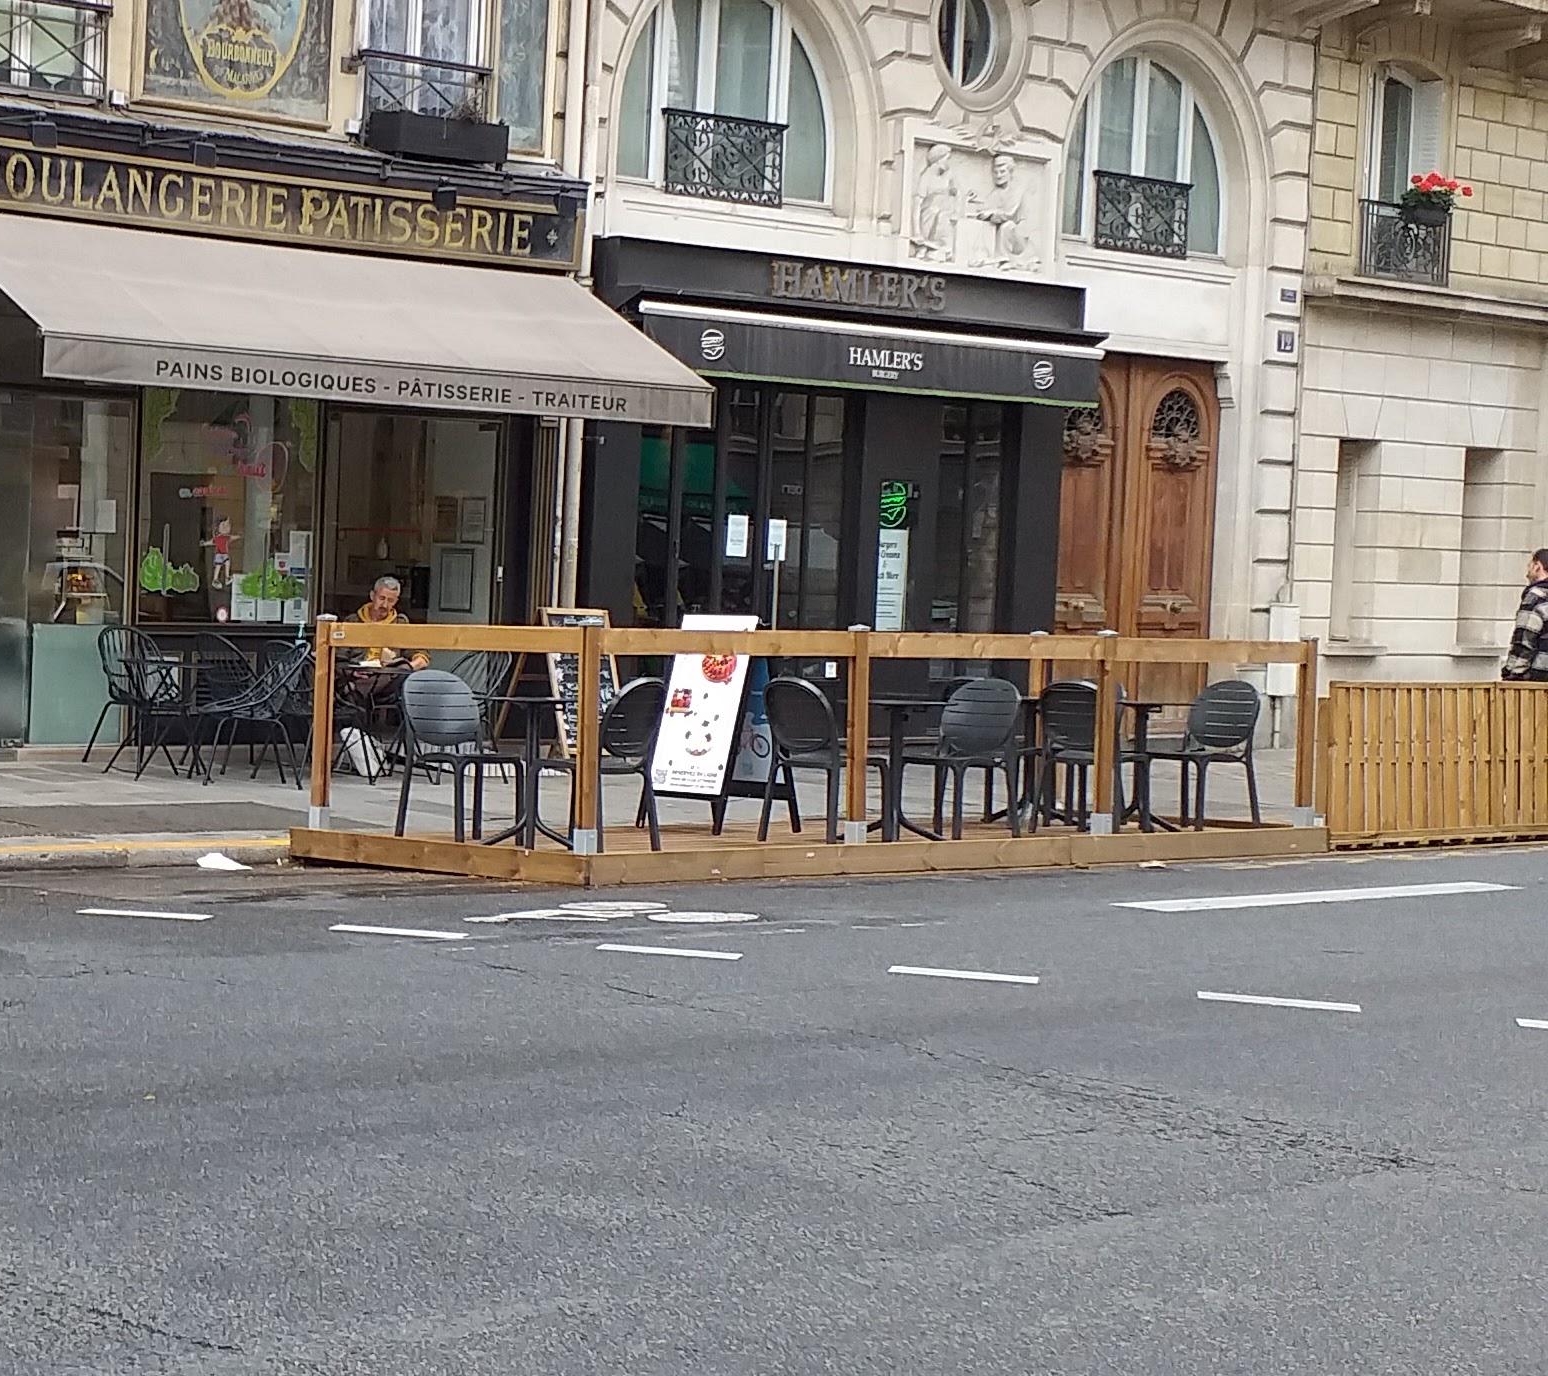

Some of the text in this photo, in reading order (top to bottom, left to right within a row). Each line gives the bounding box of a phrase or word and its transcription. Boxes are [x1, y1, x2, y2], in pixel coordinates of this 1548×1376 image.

[298, 187, 534, 256] PATISSERIE
[772, 259, 947, 312] HAMLER'S
[849, 346, 924, 372] HAMLER'S
[1280, 332, 1292, 350] 12
[155, 360, 223, 381] PAINS
[231, 366, 377, 394] BIOLOGIQUES
[397, 377, 512, 404] PÂTISSERIE
[532, 391, 627, 413] TRAITEUR
